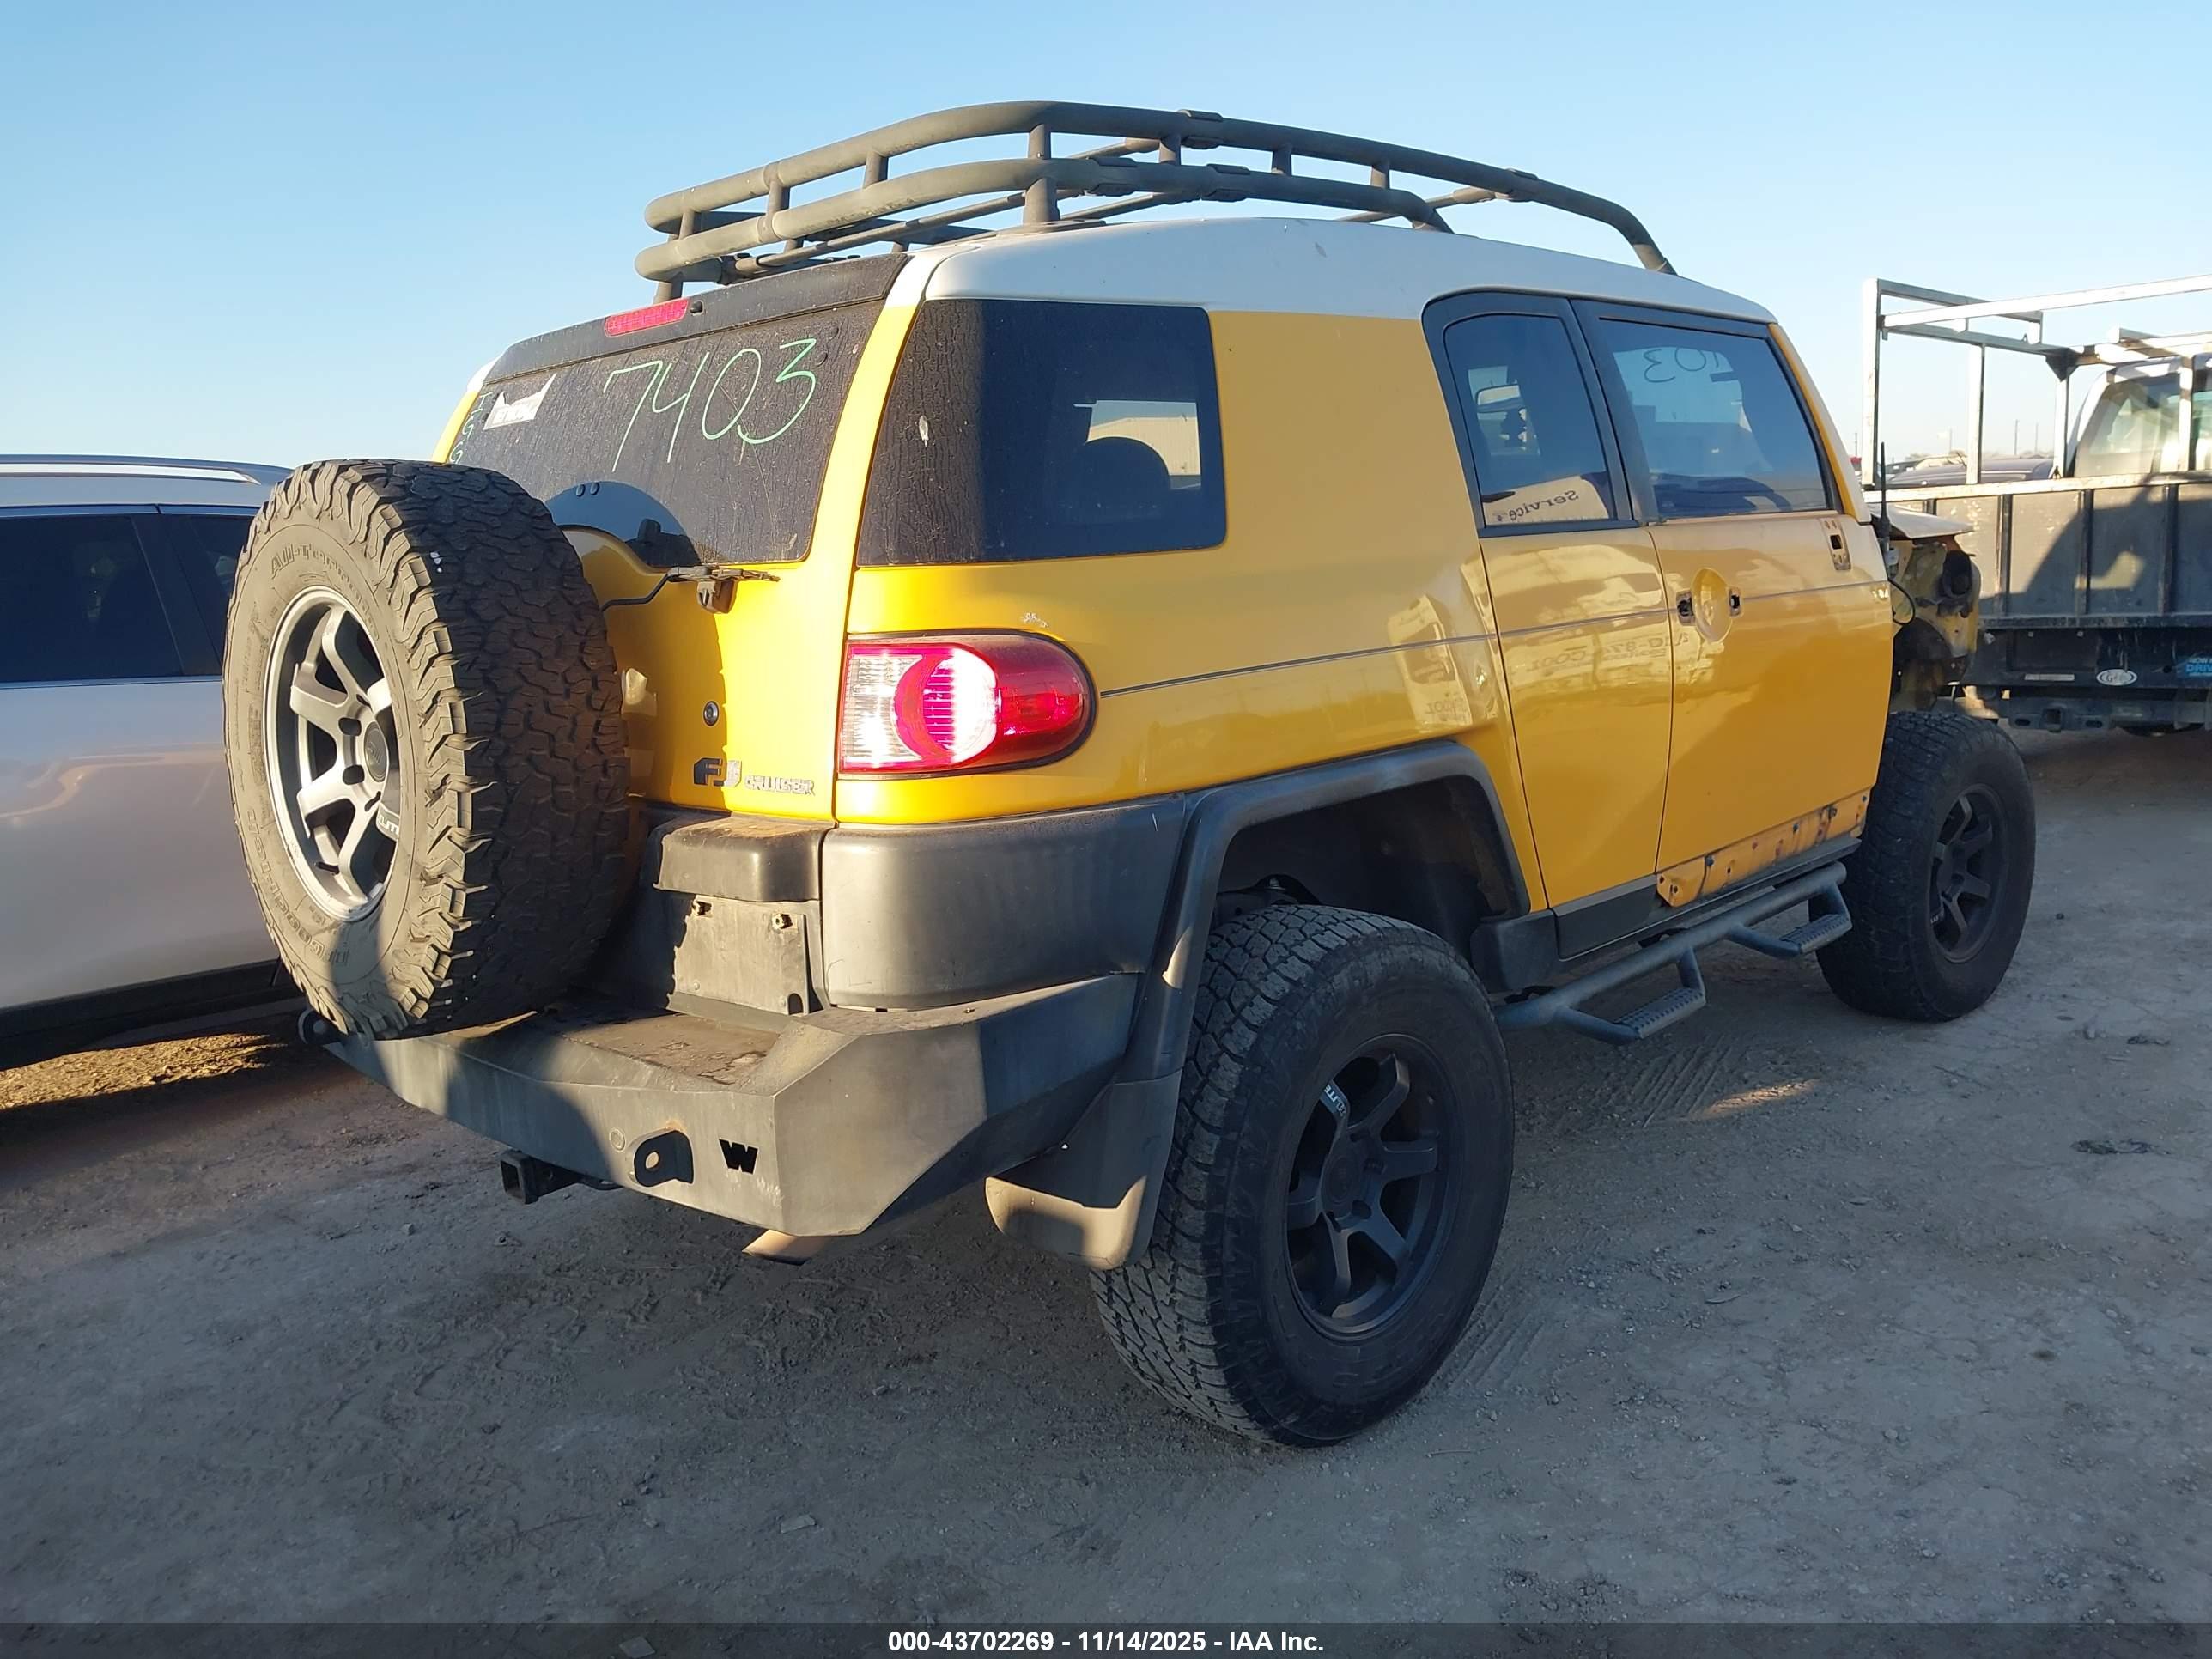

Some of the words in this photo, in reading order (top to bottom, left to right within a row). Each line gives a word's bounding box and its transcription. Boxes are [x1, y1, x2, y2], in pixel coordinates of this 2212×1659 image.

[603, 337, 817, 472] 7403
[693, 757, 743, 788] FJ
[744, 775, 816, 796] CRUISER
[718, 1138, 759, 1176] W
